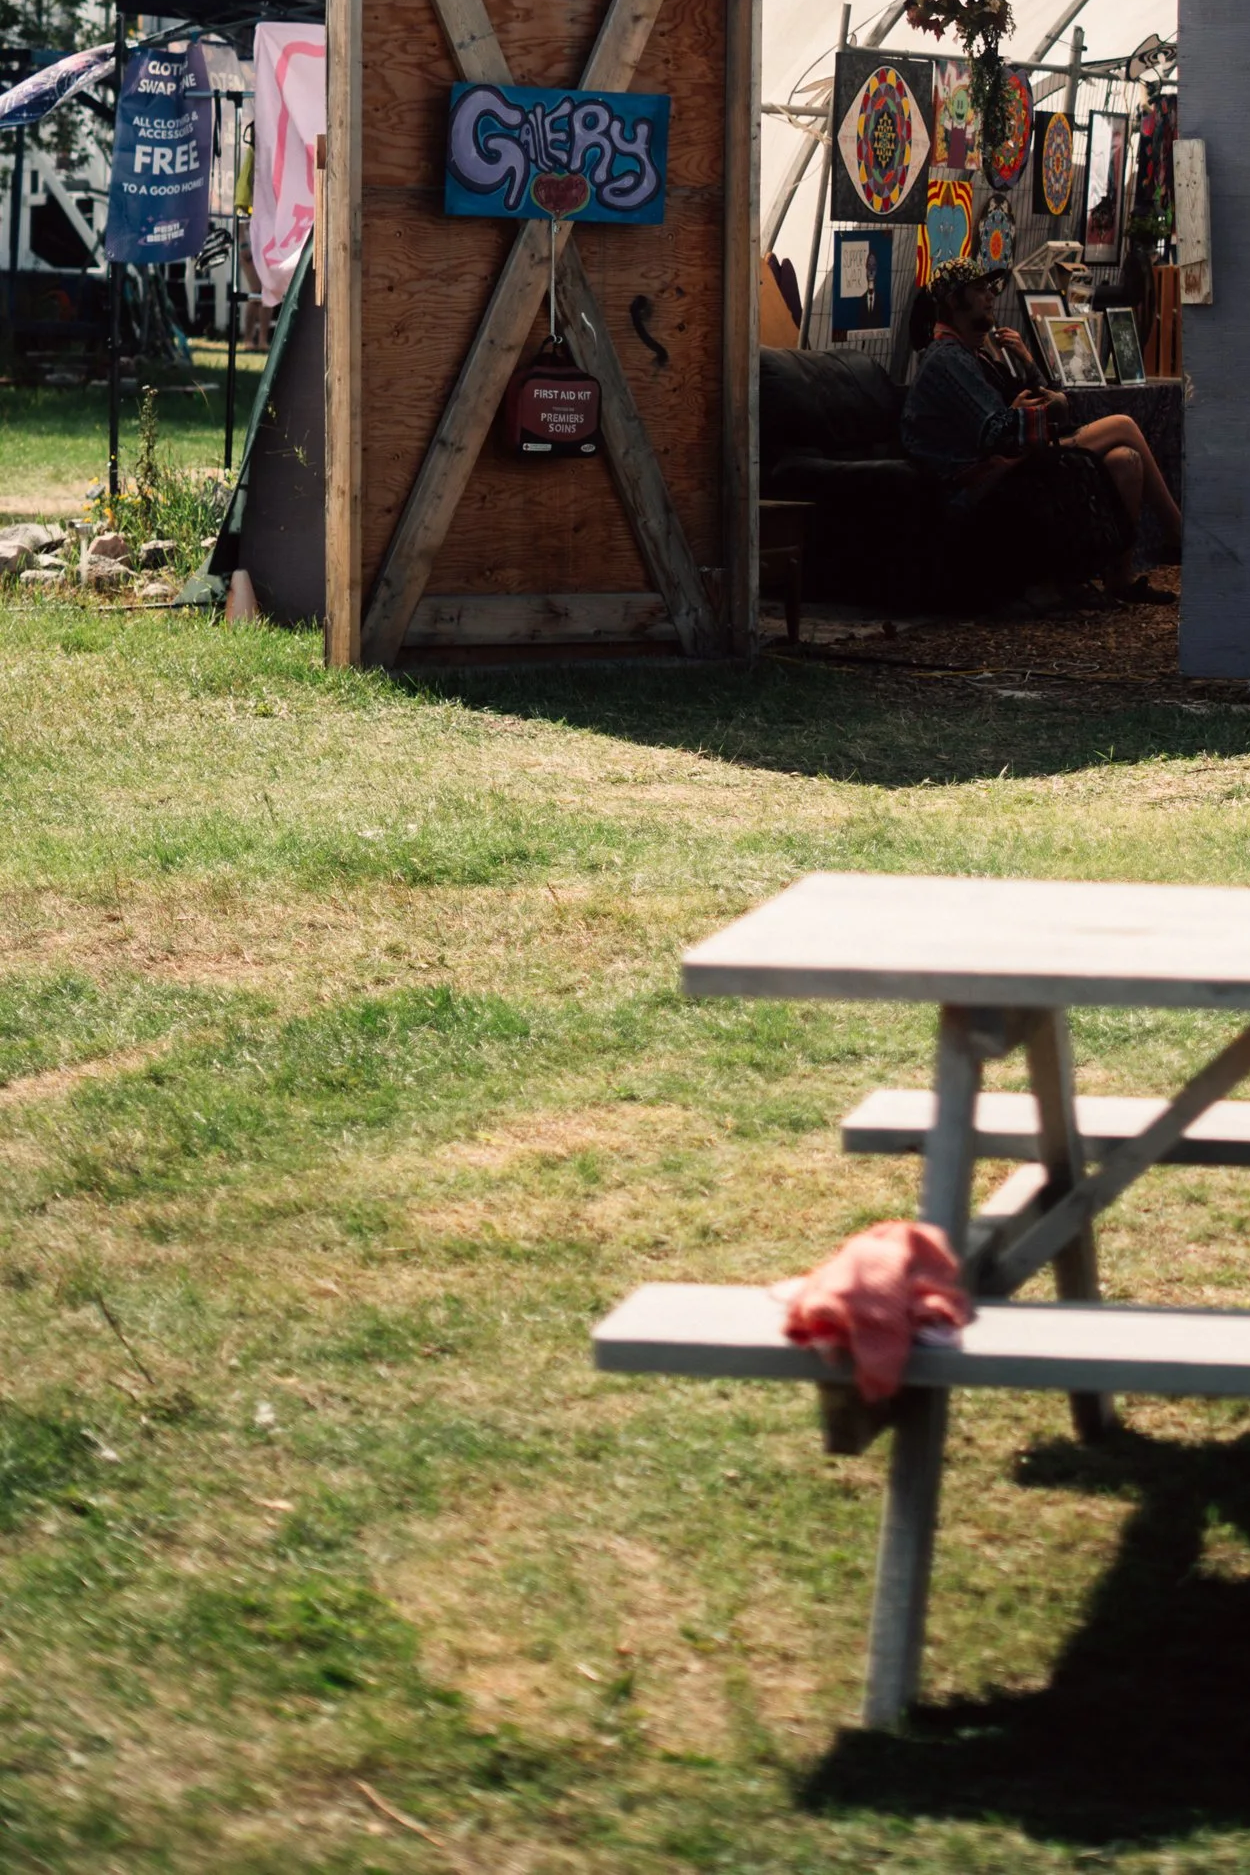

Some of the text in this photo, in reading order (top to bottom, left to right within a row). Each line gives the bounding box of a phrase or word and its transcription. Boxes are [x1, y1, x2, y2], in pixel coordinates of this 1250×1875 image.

[138, 78, 176, 95] SWAP
[132, 115, 151, 127] ALL
[134, 139, 200, 175] FREE
[122, 182, 137, 194] TO
[139, 185, 147, 195] A
[149, 184, 181, 196] GOOD
[533, 389, 592, 401] FIRST AID KIT
[540, 412, 584, 424] PREMIERS
[548, 423, 577, 434] SOINS
